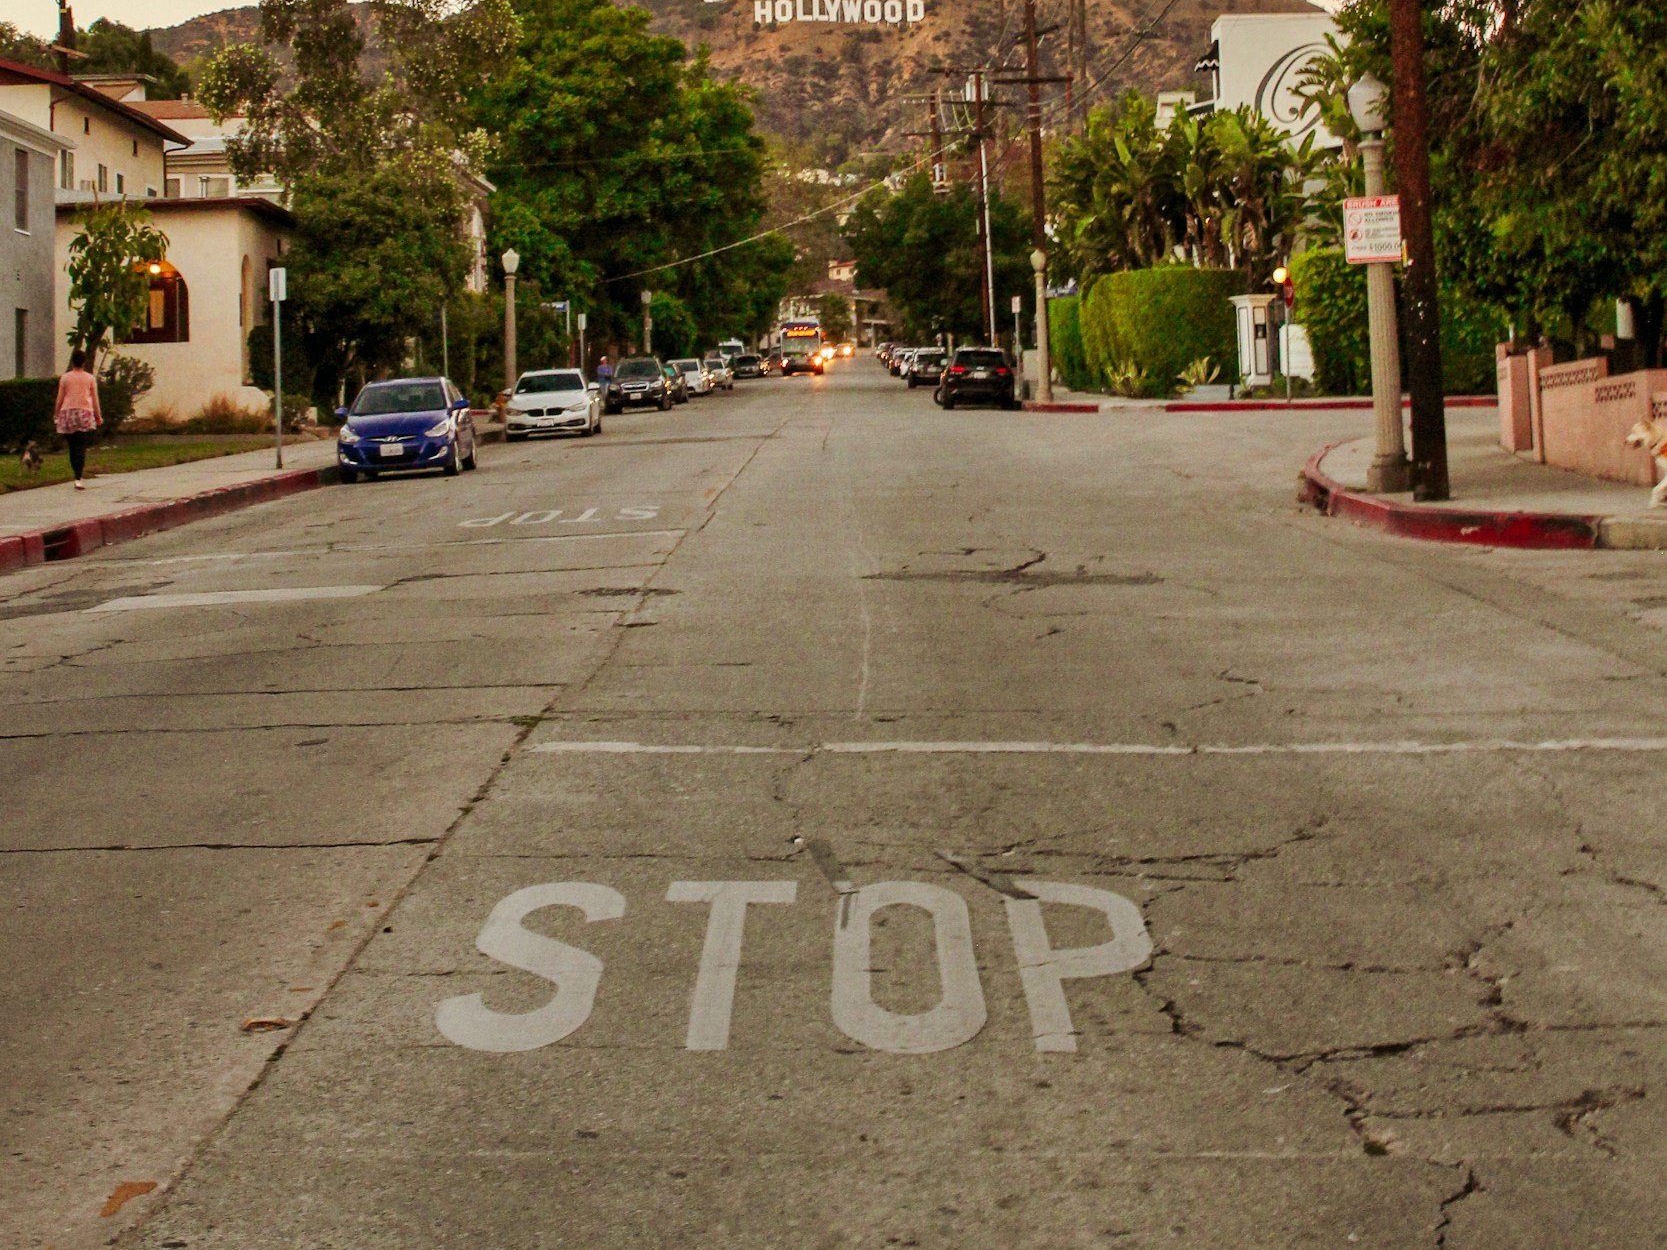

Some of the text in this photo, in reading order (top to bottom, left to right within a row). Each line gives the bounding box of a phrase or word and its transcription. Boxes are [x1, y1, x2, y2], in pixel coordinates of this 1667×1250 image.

[1347, 196, 1399, 209] BRUSH ARE
[457, 505, 662, 527] STOP
[434, 880, 1154, 1052] STOP
